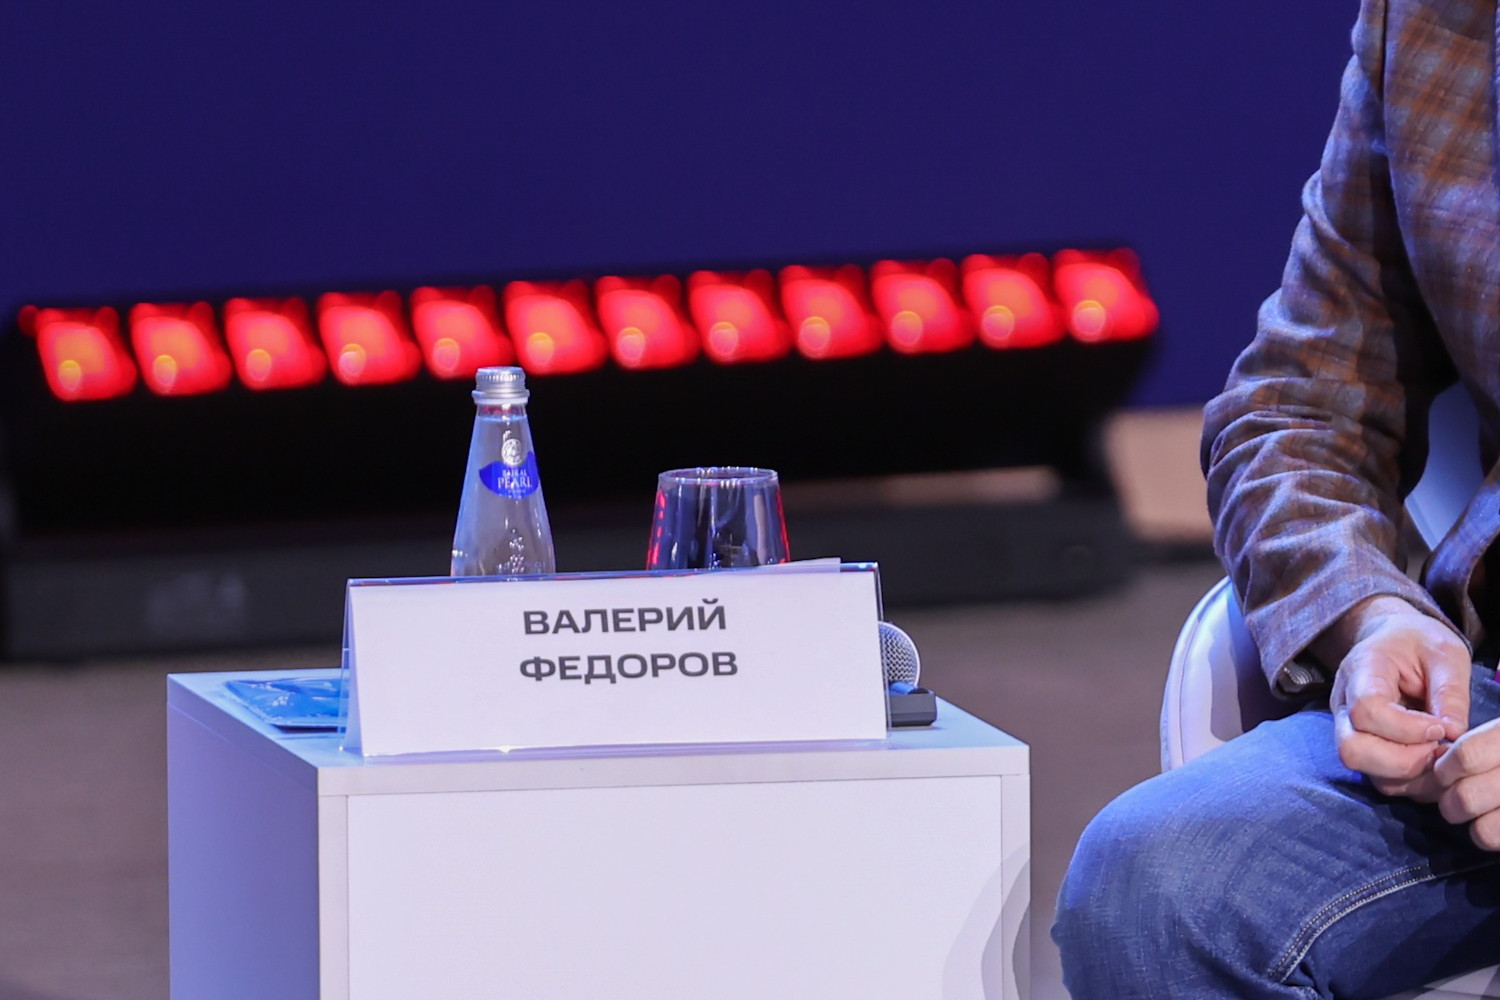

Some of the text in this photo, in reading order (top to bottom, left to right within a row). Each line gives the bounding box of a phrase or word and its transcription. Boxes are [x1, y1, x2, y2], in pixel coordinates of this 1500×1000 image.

[497, 477, 533, 489] PEARL
[523, 598, 727, 635] ВАЛЕРИЙ
[519, 651, 738, 684] ФЕДОРОВ
